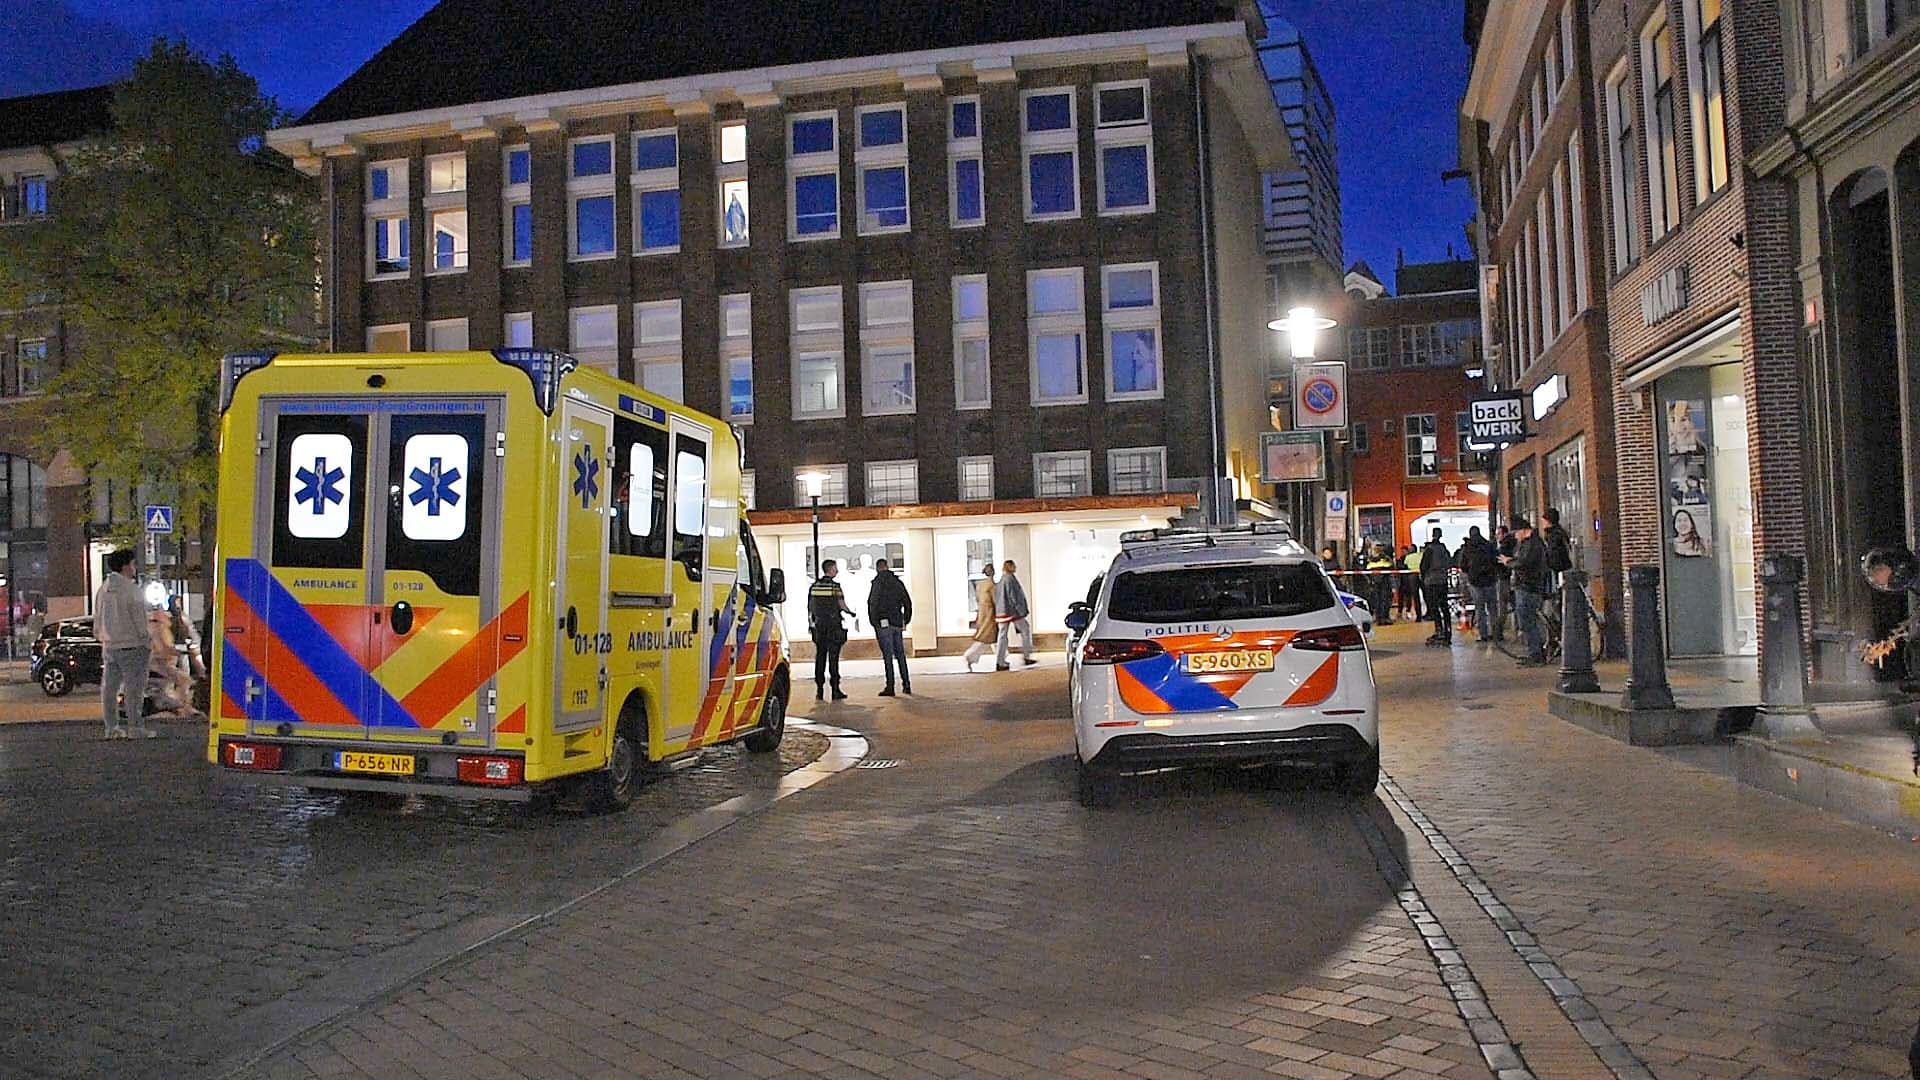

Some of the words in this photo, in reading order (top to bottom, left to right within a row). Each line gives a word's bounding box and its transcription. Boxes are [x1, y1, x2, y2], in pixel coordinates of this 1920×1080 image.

[1475, 401, 1518, 419] back
[1473, 421, 1522, 437] WERK
[293, 580, 358, 589] AMBULANCE
[393, 582, 424, 591] 01-128
[1144, 623, 1210, 637] POLITIE
[574, 632, 612, 655] 01-128
[627, 630, 693, 651] AMBULANCE
[1193, 652, 1267, 669] S-960-XS
[345, 754, 410, 771] P-656-NR
